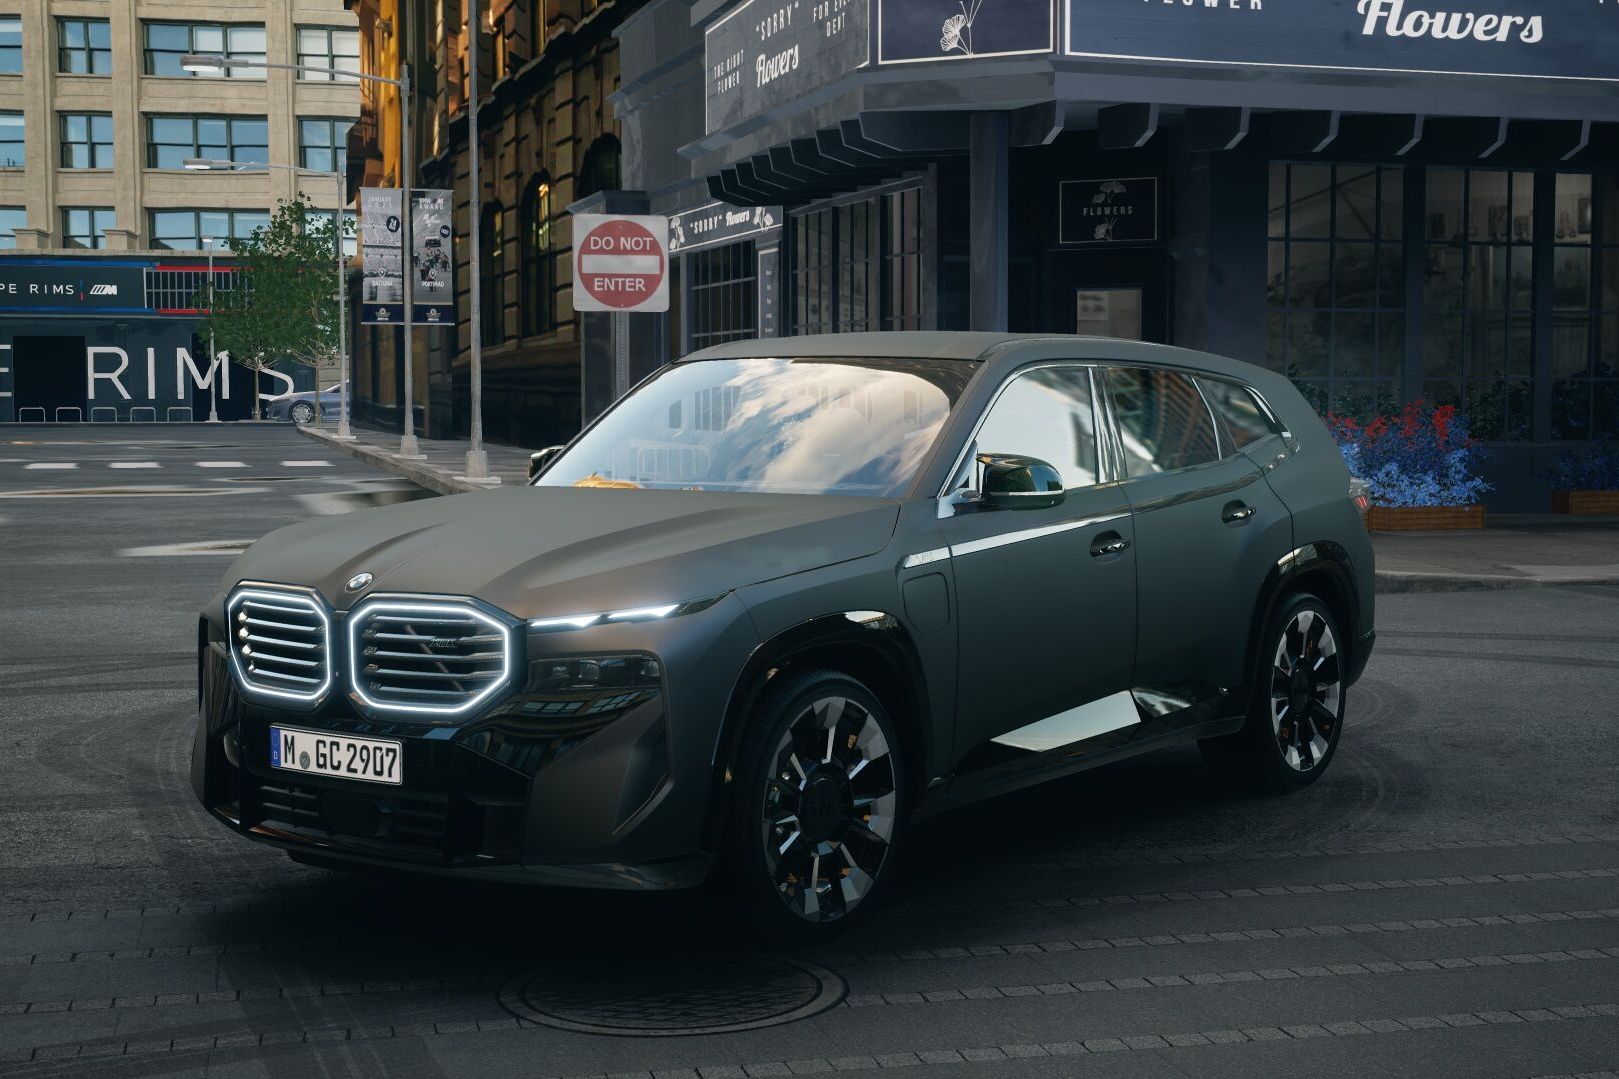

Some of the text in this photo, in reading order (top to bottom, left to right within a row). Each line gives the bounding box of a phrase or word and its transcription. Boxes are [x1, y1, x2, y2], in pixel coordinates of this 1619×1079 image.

[813, 1, 829, 23] FOR
[1357, 0, 1543, 43] Flowers
[827, 12, 845, 38] DENT
[714, 49, 744, 79] THE RIGHT
[756, 44, 798, 87] Flowers
[718, 70, 740, 95] FLOWER
[1083, 206, 1134, 216] FLOWERS
[590, 236, 654, 251] DO NOT
[29, 284, 74, 295] RIMS
[594, 277, 646, 292] ENTER
[284, 733, 295, 765] M
